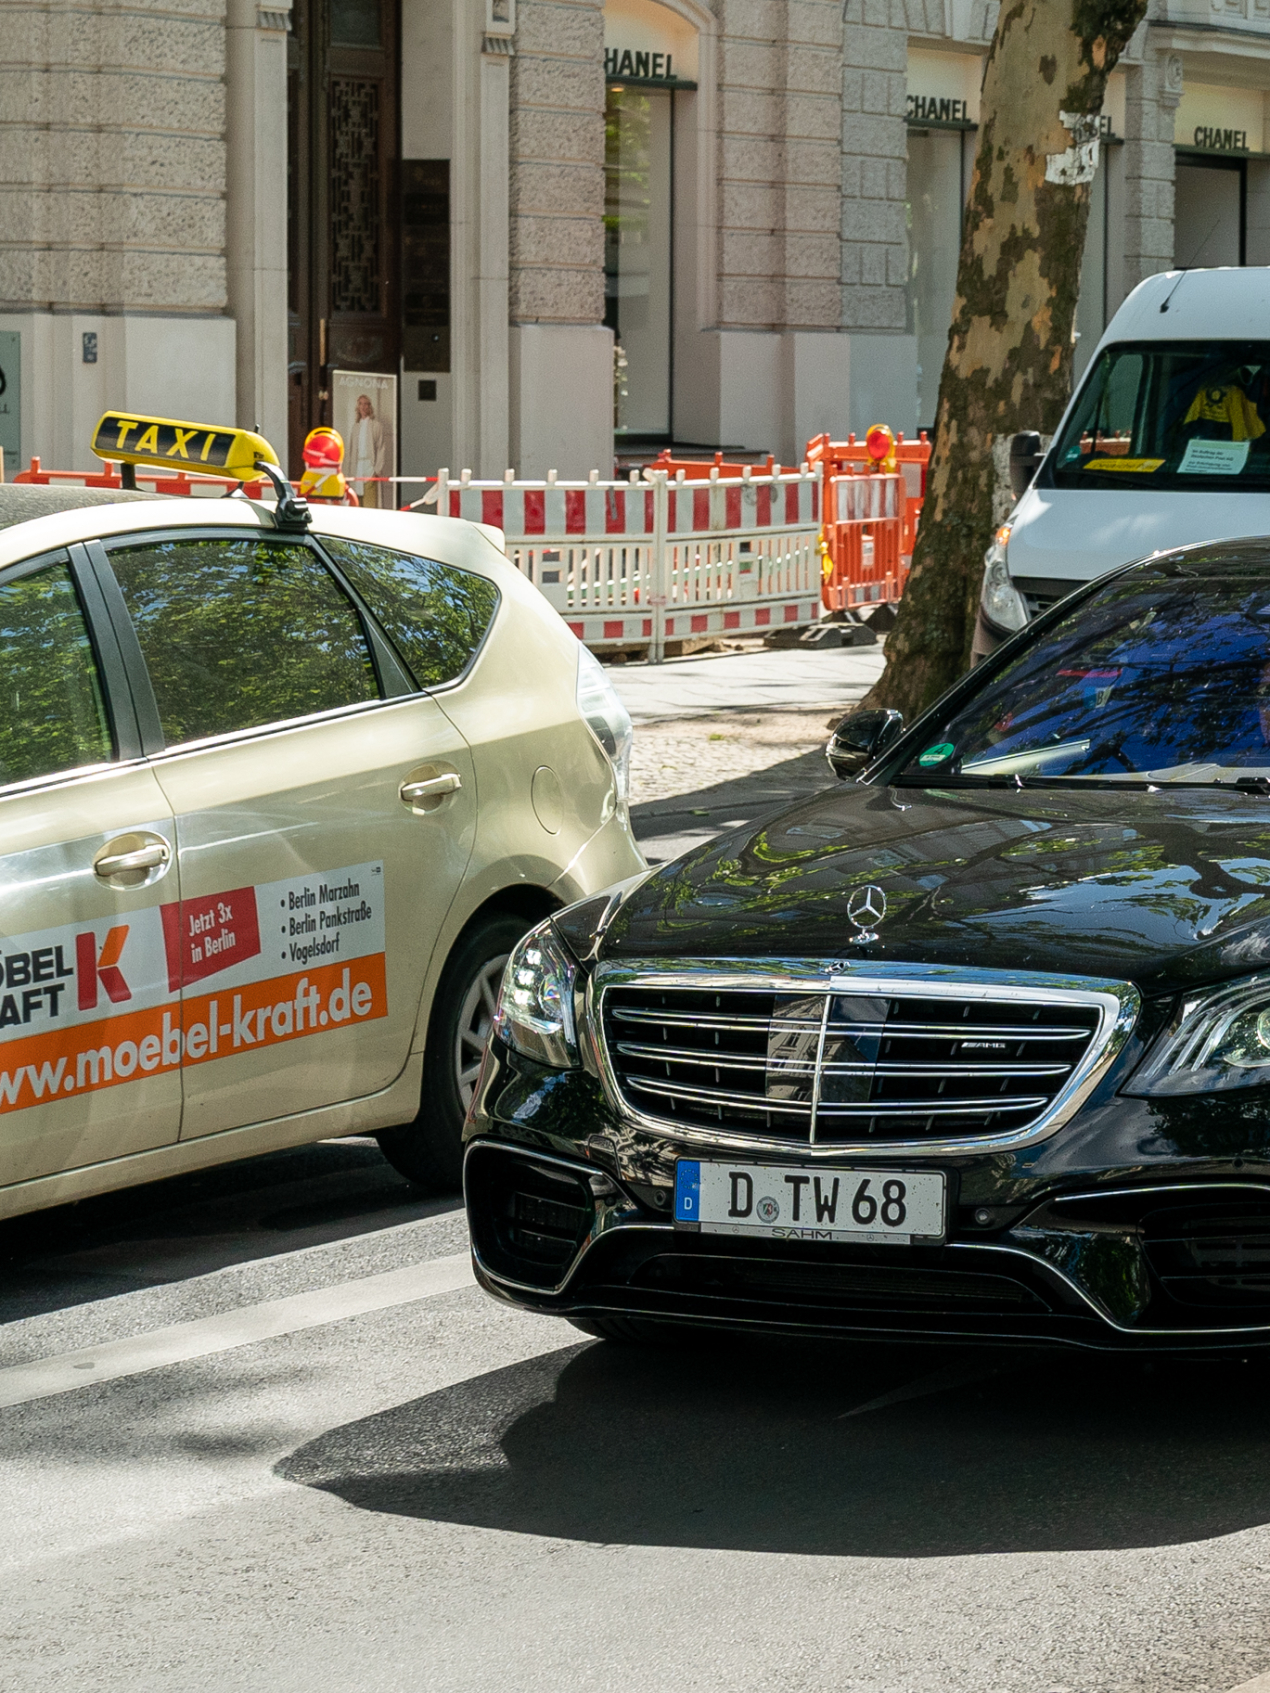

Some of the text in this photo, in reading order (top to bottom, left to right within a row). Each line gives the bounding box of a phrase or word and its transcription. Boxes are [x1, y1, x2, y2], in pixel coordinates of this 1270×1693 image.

[603, 47, 678, 80] HANEL
[1194, 126, 1250, 152] CHANEL
[116, 420, 217, 462] TAXI
[288, 878, 360, 911] Berlin Marzahn
[189, 902, 233, 937] Jetzt 3x
[289, 901, 372, 937] Berlin Pankstraße
[191, 930, 236, 964] in Berlin
[289, 932, 340, 965] Vogelsdorf
[0, 945, 74, 990] BEL
[683, 1197, 693, 1210] D
[728, 1171, 907, 1228] D TW 68
[771, 1227, 833, 1241] SAHM
